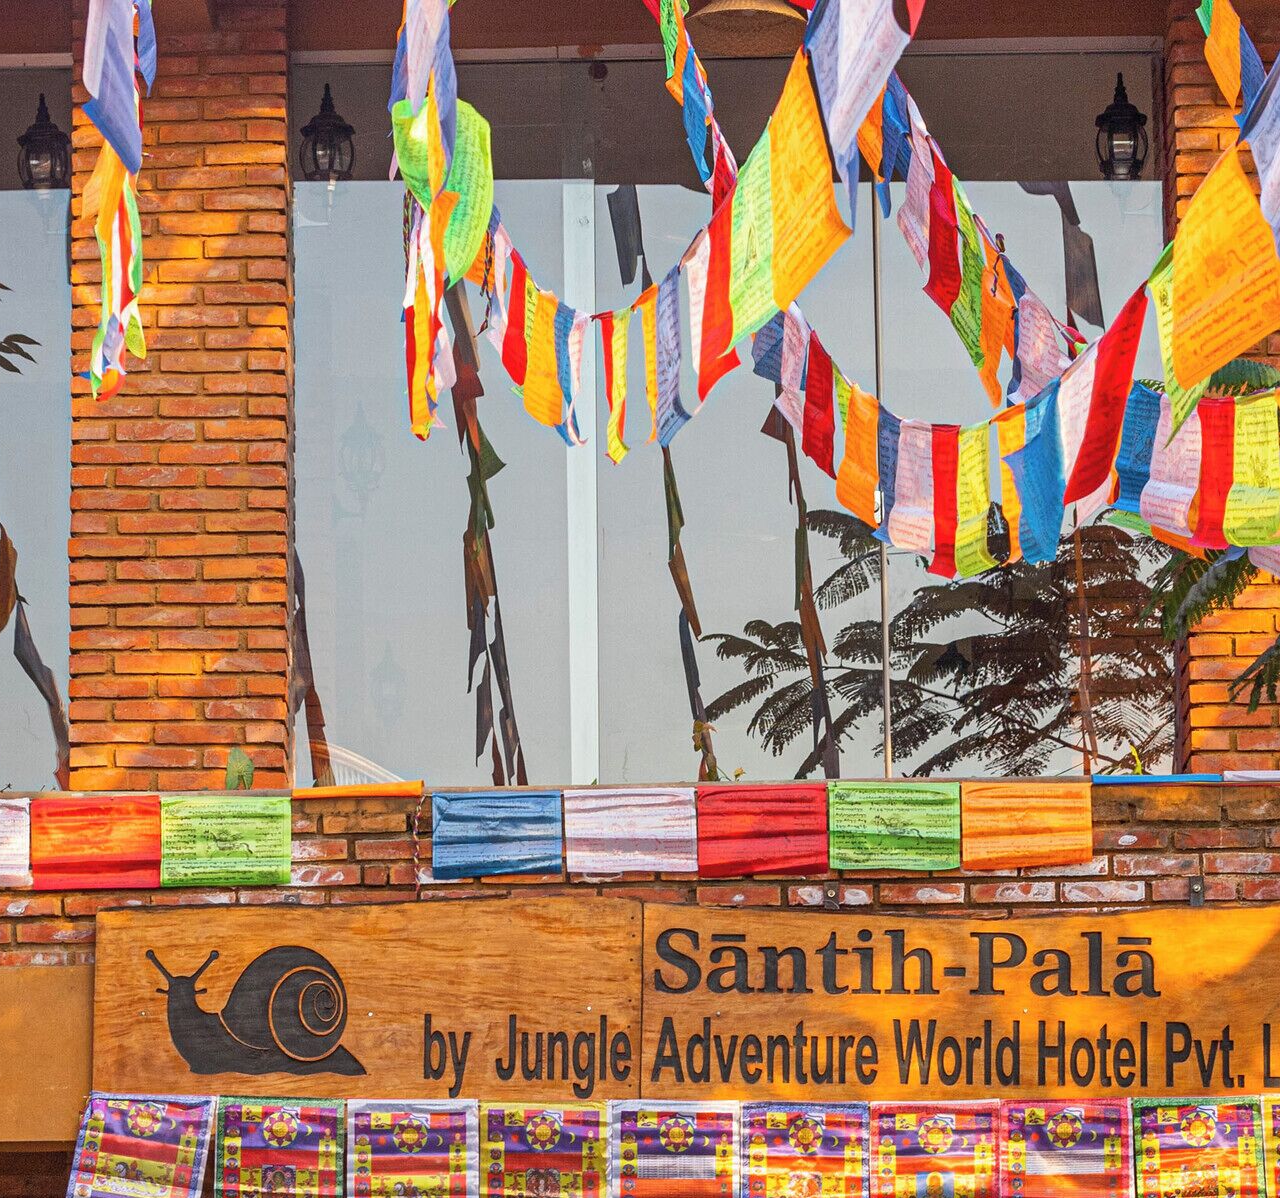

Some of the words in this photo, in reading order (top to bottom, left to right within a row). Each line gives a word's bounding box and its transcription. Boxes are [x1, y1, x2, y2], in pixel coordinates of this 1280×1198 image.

[654, 926, 1163, 998] Sāntih-Palā
[423, 1013, 472, 1099] by
[495, 1014, 633, 1100] Jungle
[651, 1016, 878, 1086] Adventure
[893, 1019, 1021, 1087] World
[1038, 1020, 1149, 1088] Hotel
[1165, 1021, 1246, 1090] Pvt.
